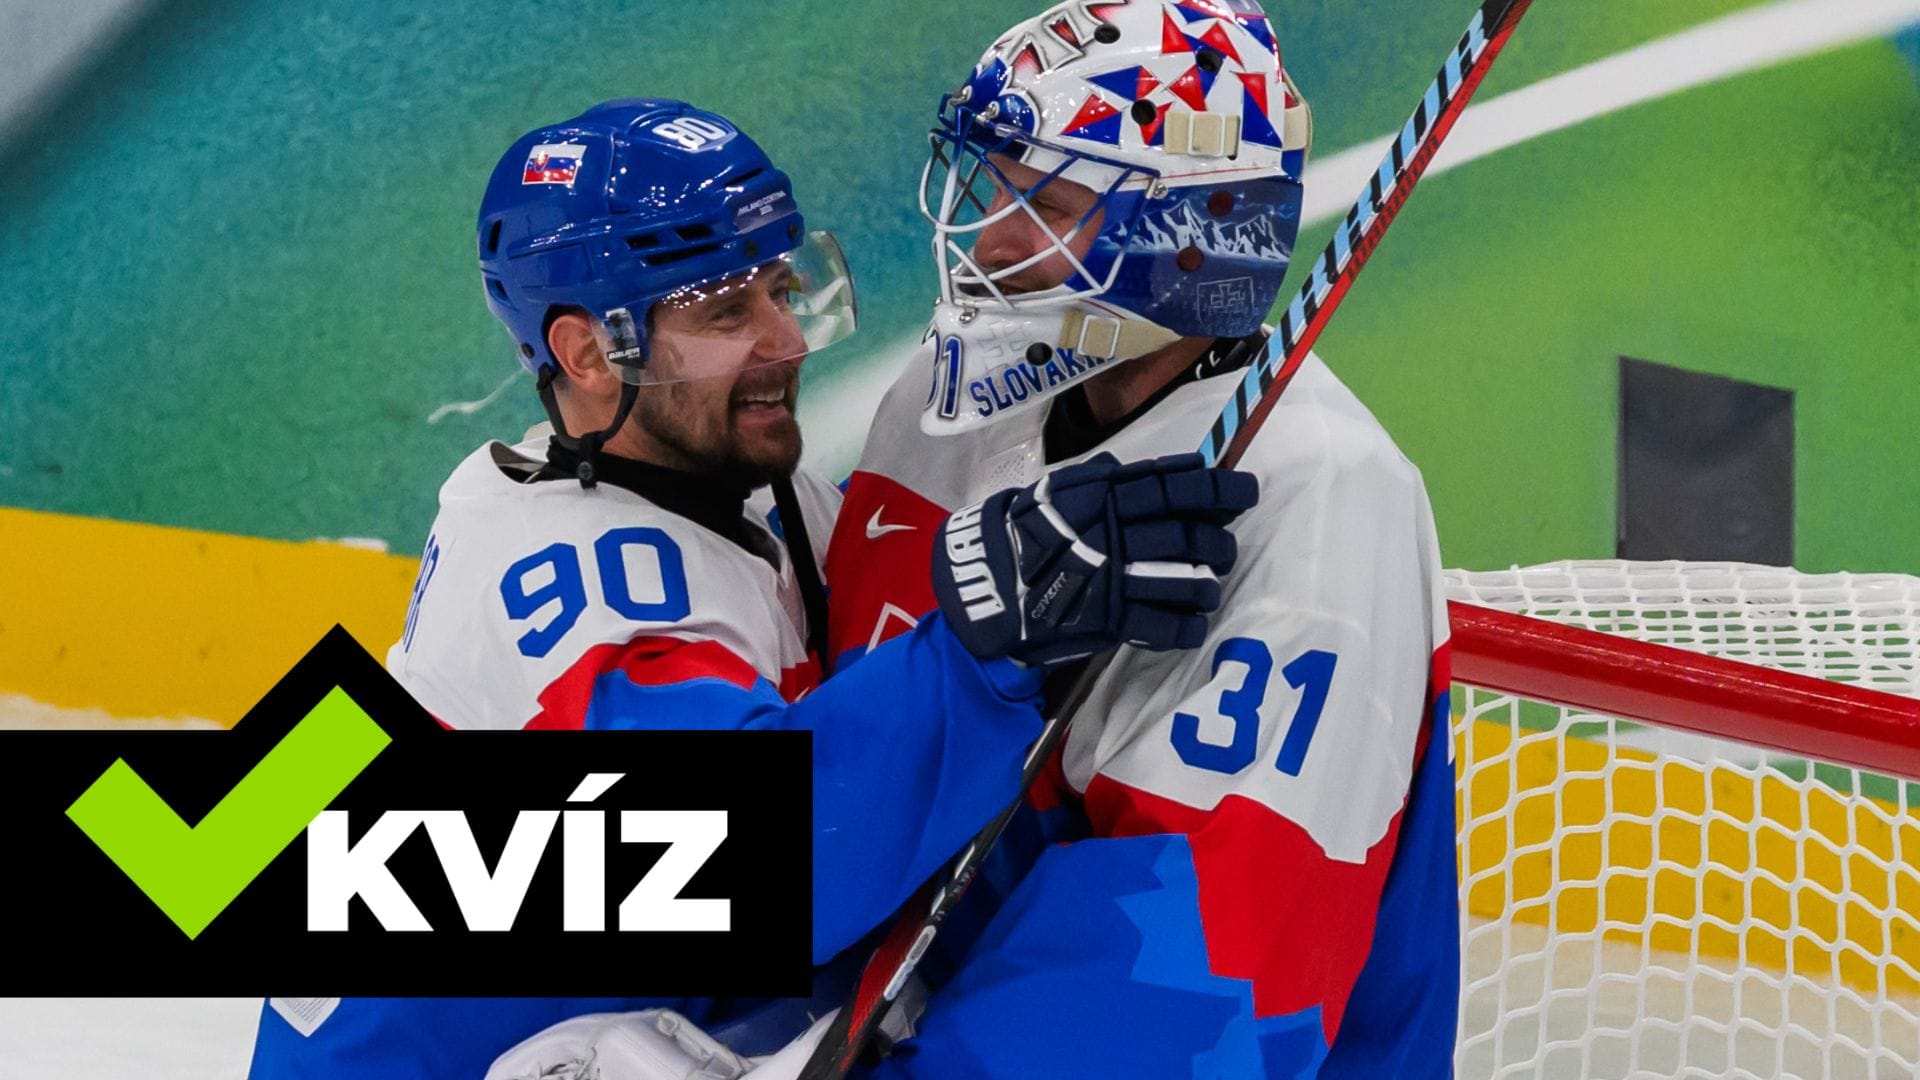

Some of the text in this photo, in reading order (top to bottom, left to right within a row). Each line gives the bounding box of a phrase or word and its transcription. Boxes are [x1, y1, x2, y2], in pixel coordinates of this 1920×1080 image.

[969, 347, 1116, 417] SLOVAK
[500, 527, 691, 658] 90
[1170, 637, 1338, 777] 31
